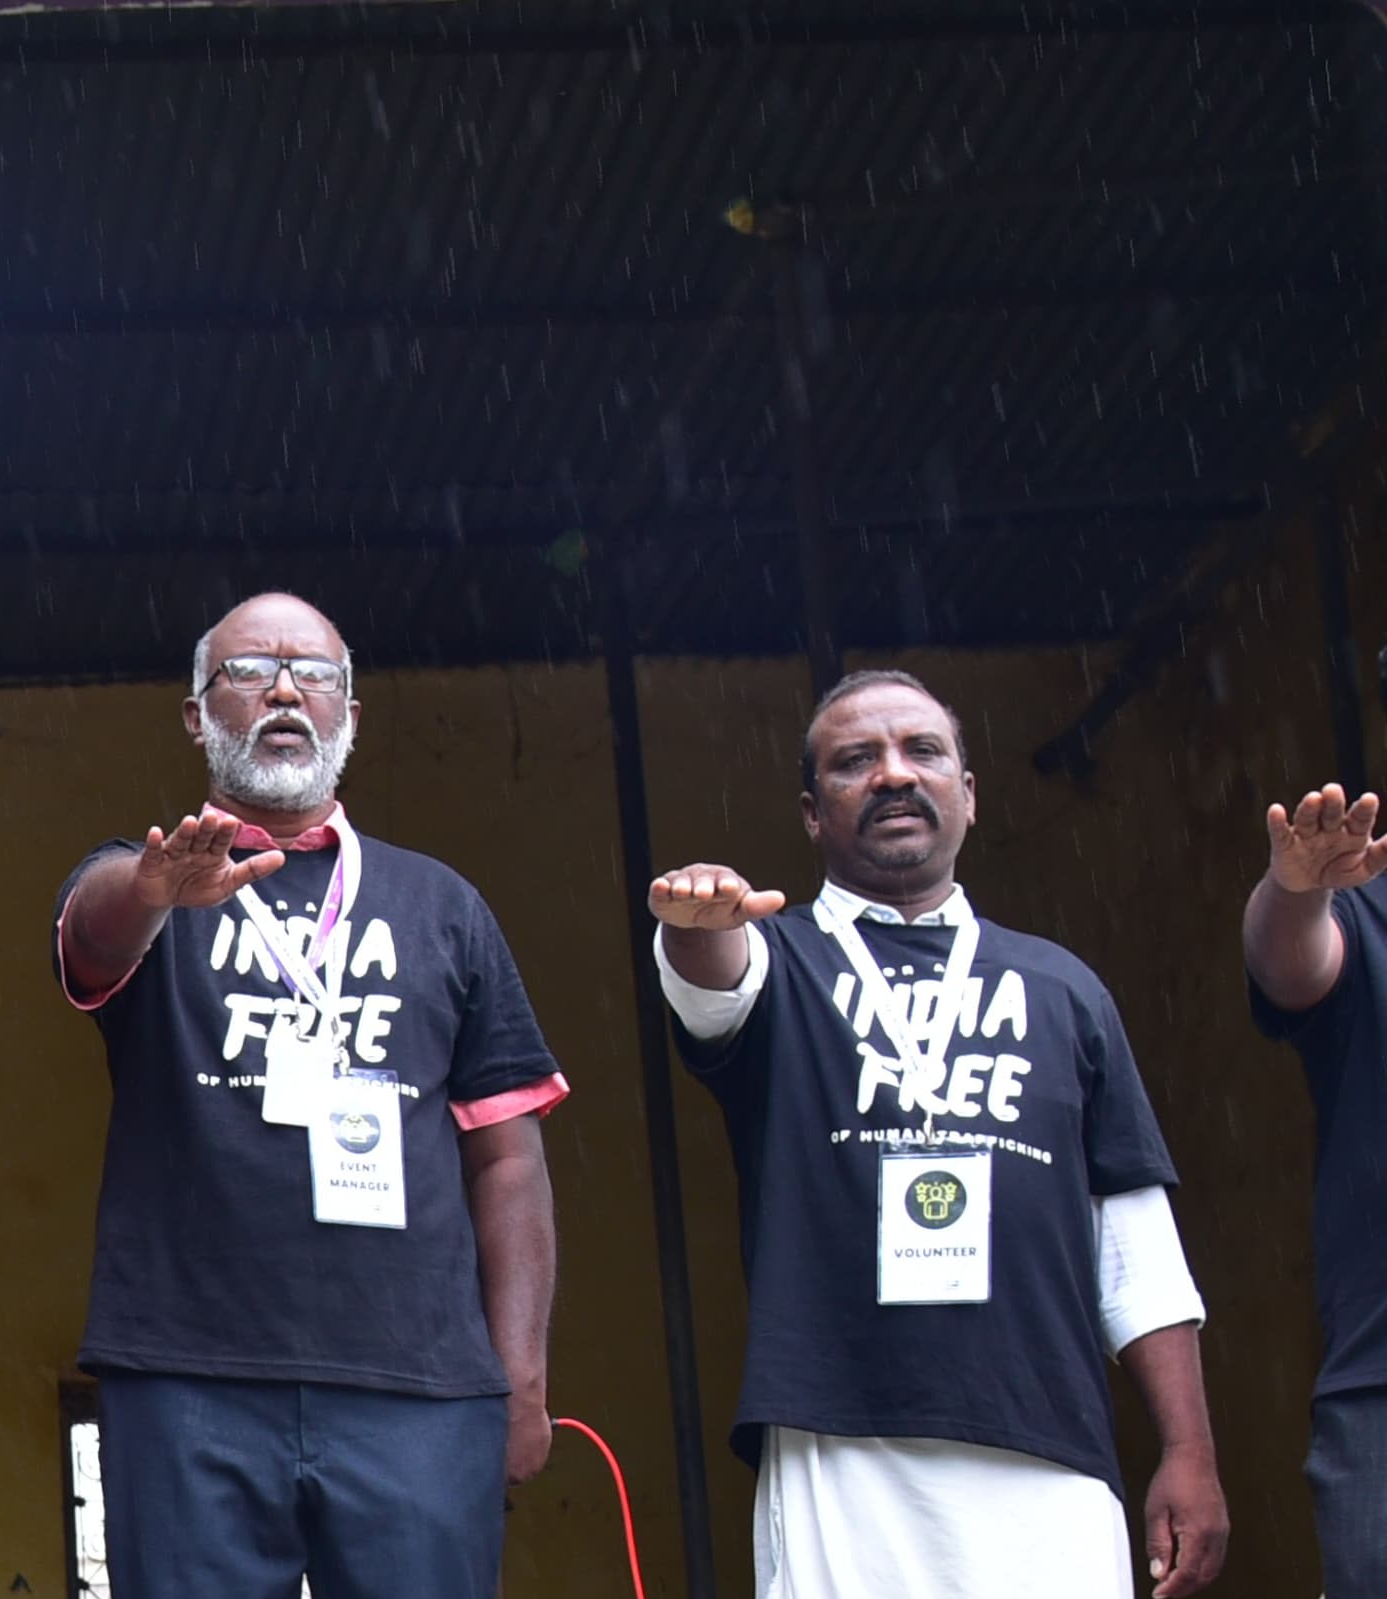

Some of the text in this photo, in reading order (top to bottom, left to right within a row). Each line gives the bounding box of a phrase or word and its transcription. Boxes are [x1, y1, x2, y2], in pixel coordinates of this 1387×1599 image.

[832, 969, 1028, 1042] INDIA
[196, 1073, 221, 1087] OF
[856, 1042, 1032, 1122] FREE
[830, 1129, 851, 1144] OF
[340, 1161, 377, 1173] EVENT
[330, 1179, 390, 1191] MANAGER
[894, 1247, 977, 1259] VOLUNTEER
